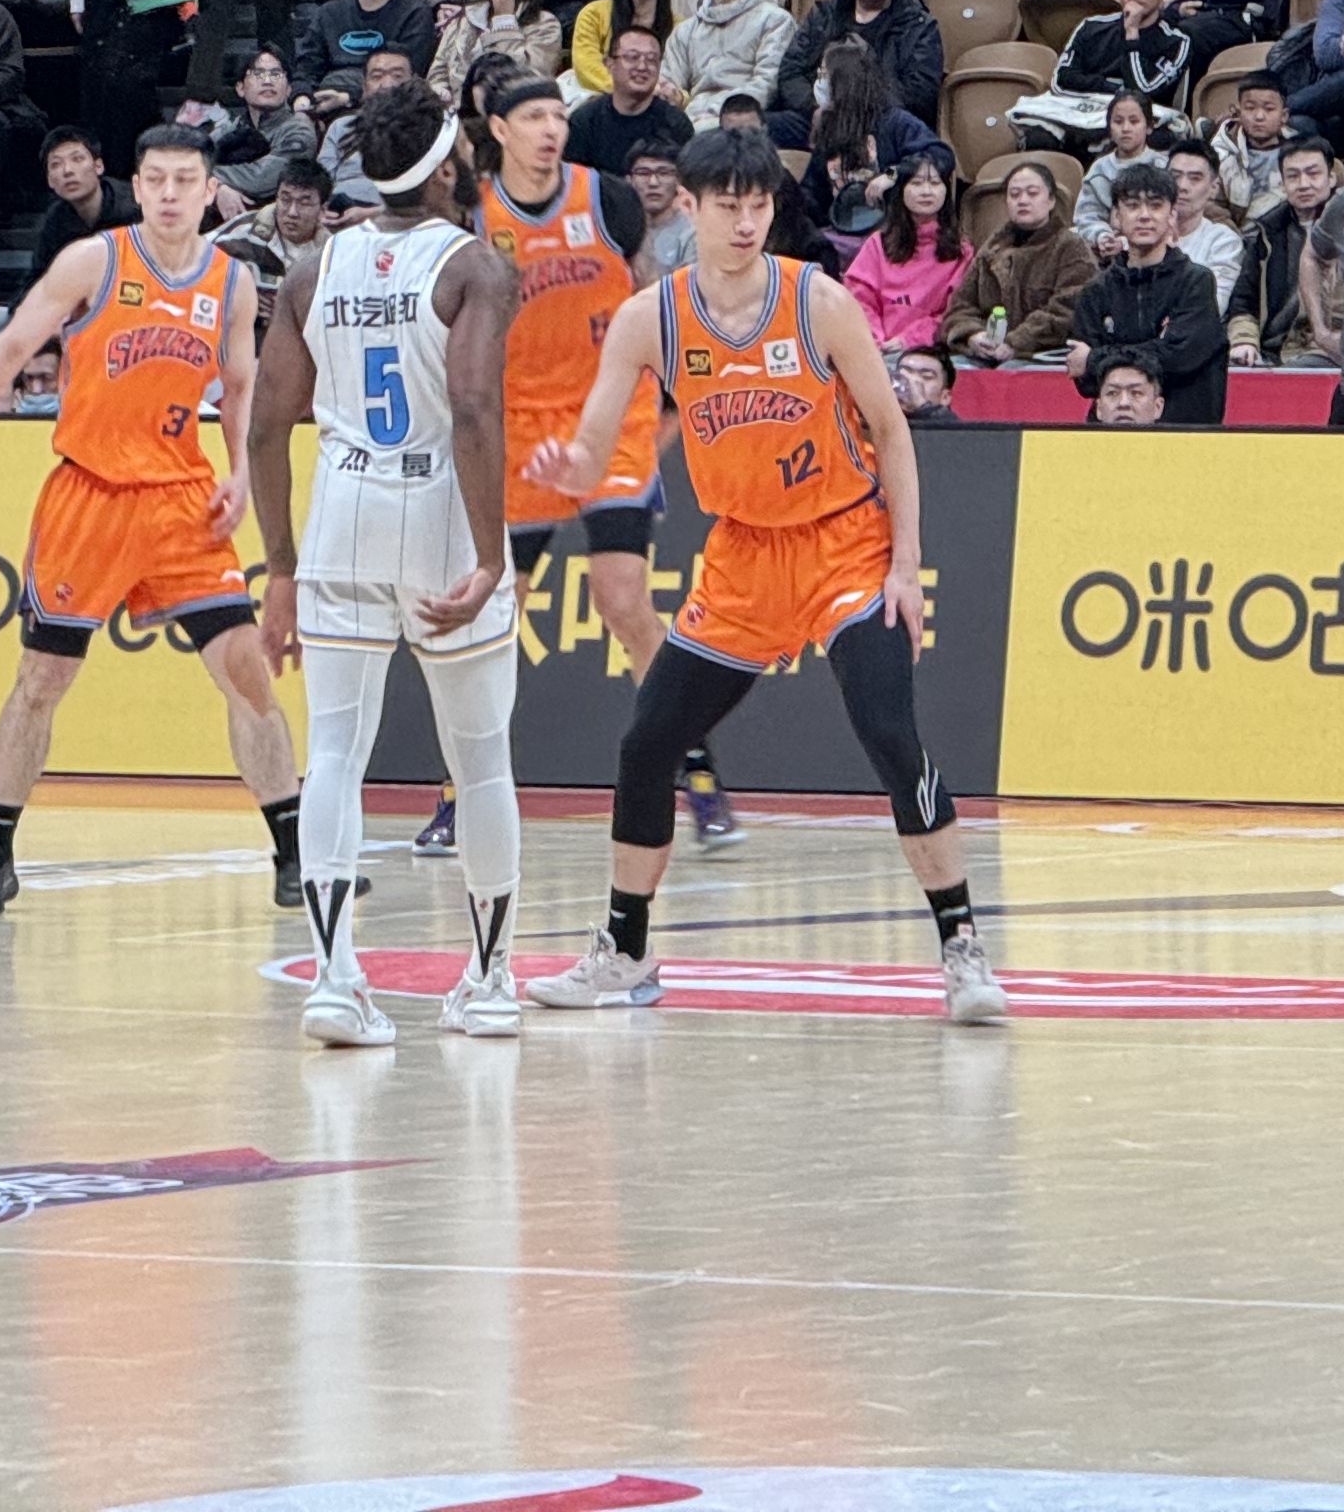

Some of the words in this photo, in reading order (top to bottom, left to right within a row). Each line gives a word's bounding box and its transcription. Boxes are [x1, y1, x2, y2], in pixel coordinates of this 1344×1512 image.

[161, 403, 192, 437] 3
[365, 346, 409, 445] 5
[689, 389, 814, 445] SHARKS
[775, 439, 823, 490] 12
